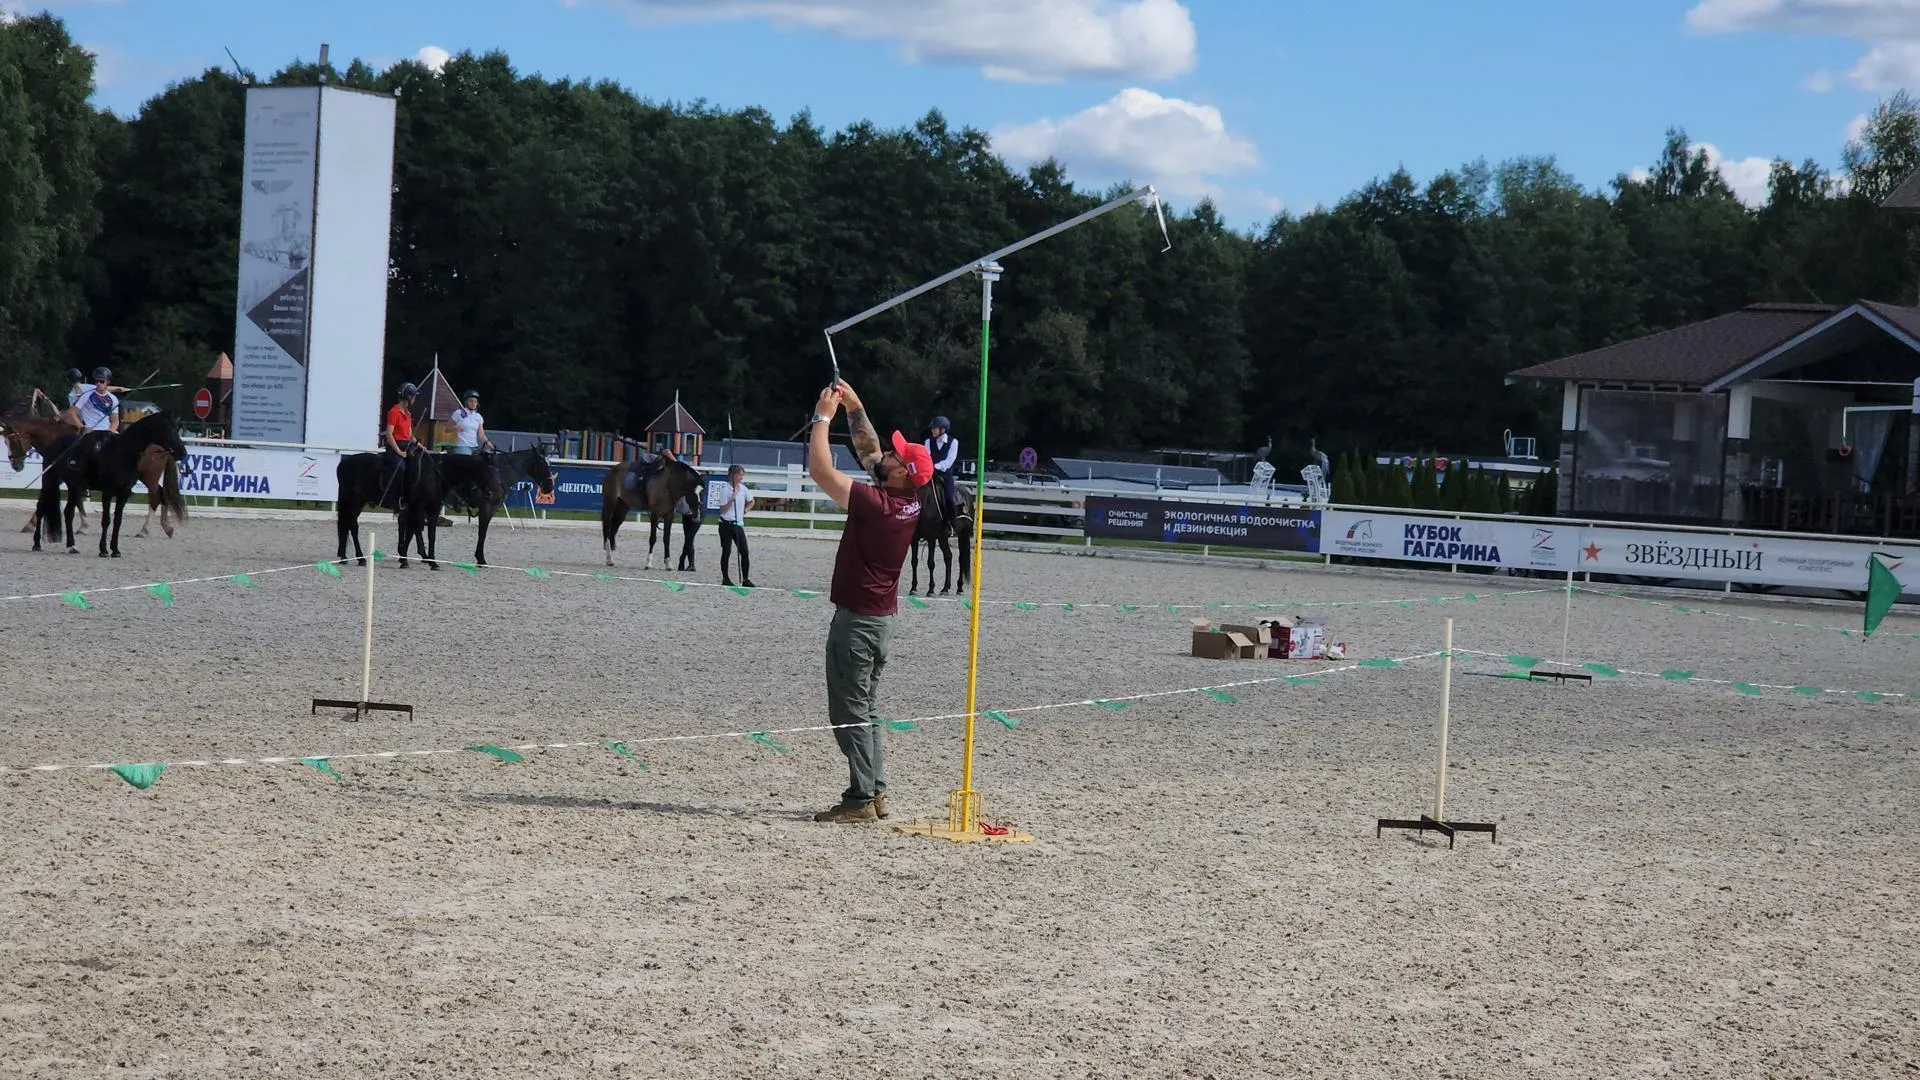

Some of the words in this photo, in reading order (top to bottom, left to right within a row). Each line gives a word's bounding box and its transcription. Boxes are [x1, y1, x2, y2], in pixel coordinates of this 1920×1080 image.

[179, 454, 236, 473] КУБОК
[178, 472, 271, 494] ГАГАРИНА
[1108, 510, 1149, 520] ОЧИСТНЫЕ
[1108, 518, 1144, 528] РЕШЕНИЯ
[1163, 510, 1237, 524] ЭКОЛОГИЧНАЯ
[1239, 515, 1316, 529] ВОДООЧИСТКА
[1163, 523, 1171, 532] И
[1173, 523, 1248, 537] ДЕЗИНФЕКЦИЯ
[1404, 523, 1462, 542] КУБОК
[1403, 540, 1501, 563] ГАГАРИНА
[1625, 540, 1764, 571] ЗВЁЗДНЫЙ
